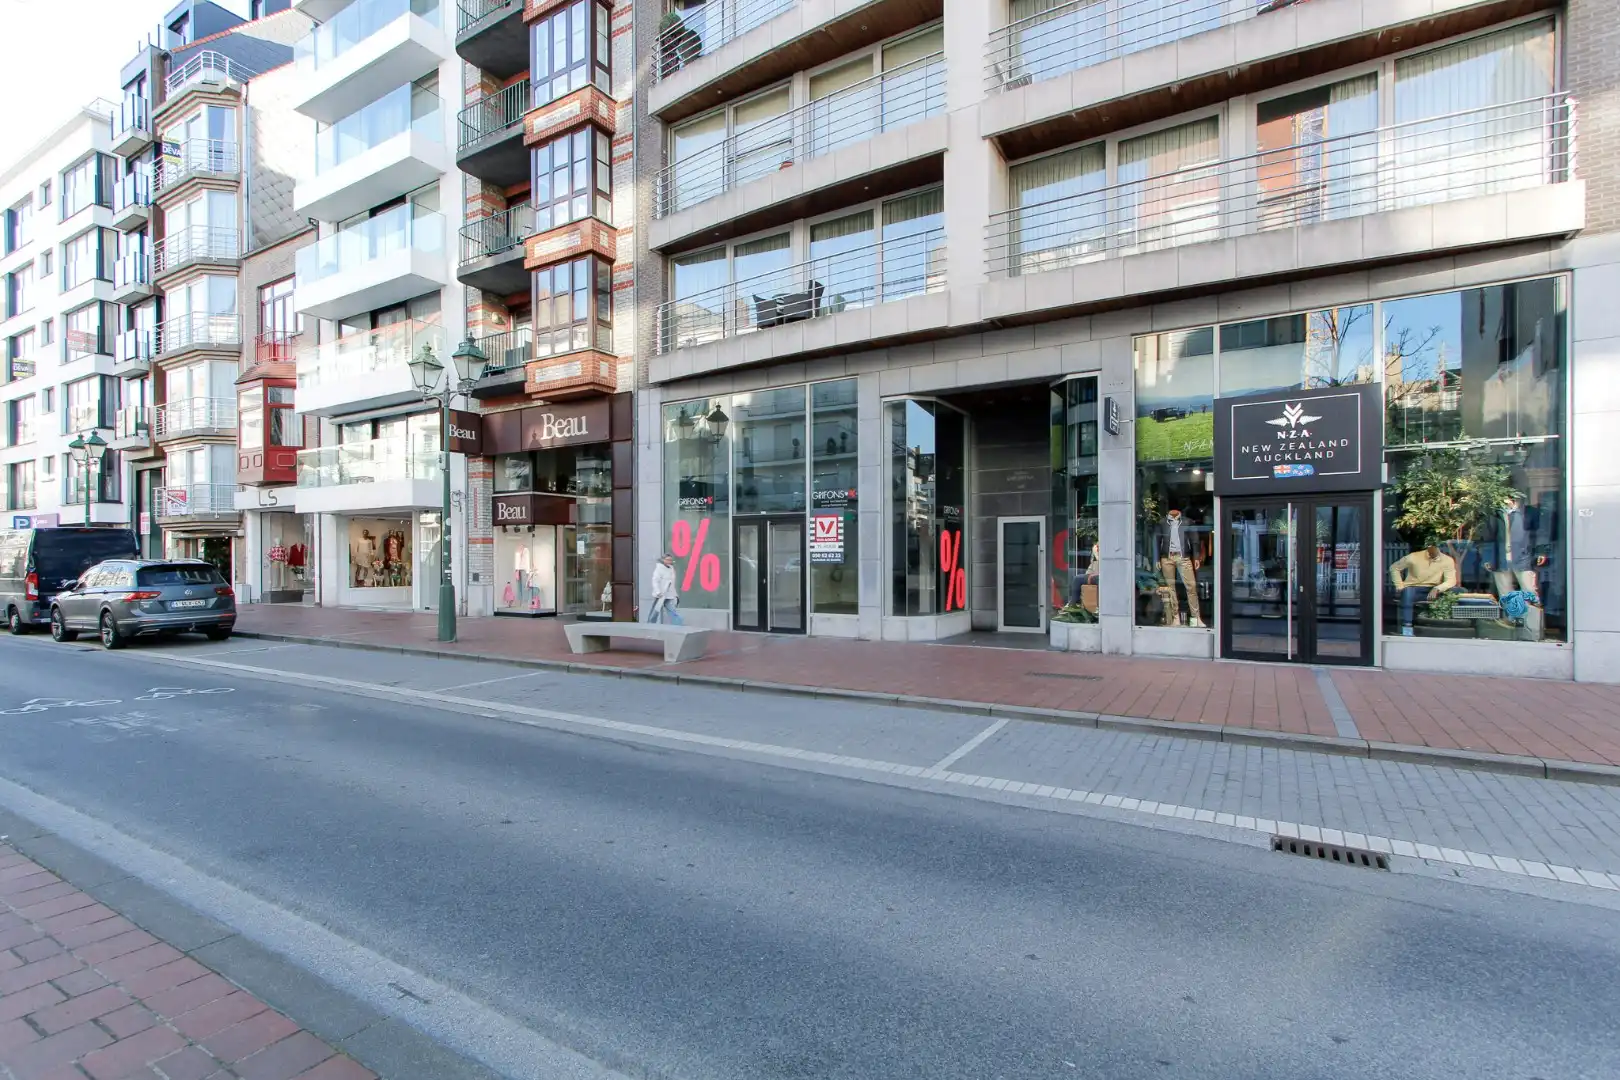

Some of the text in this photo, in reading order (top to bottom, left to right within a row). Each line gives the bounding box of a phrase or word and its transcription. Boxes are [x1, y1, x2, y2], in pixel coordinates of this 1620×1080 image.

[448, 424, 476, 440] Beau
[541, 413, 589, 440] Beau
[1241, 439, 1349, 453] NEW ZEALAND
[1254, 450, 1334, 463] AUCKLAND
[258, 489, 278, 507] LS
[497, 502, 527, 520] Beau
[15, 518, 29, 529] P
[671, 518, 721, 592] %
[940, 529, 966, 611] %
